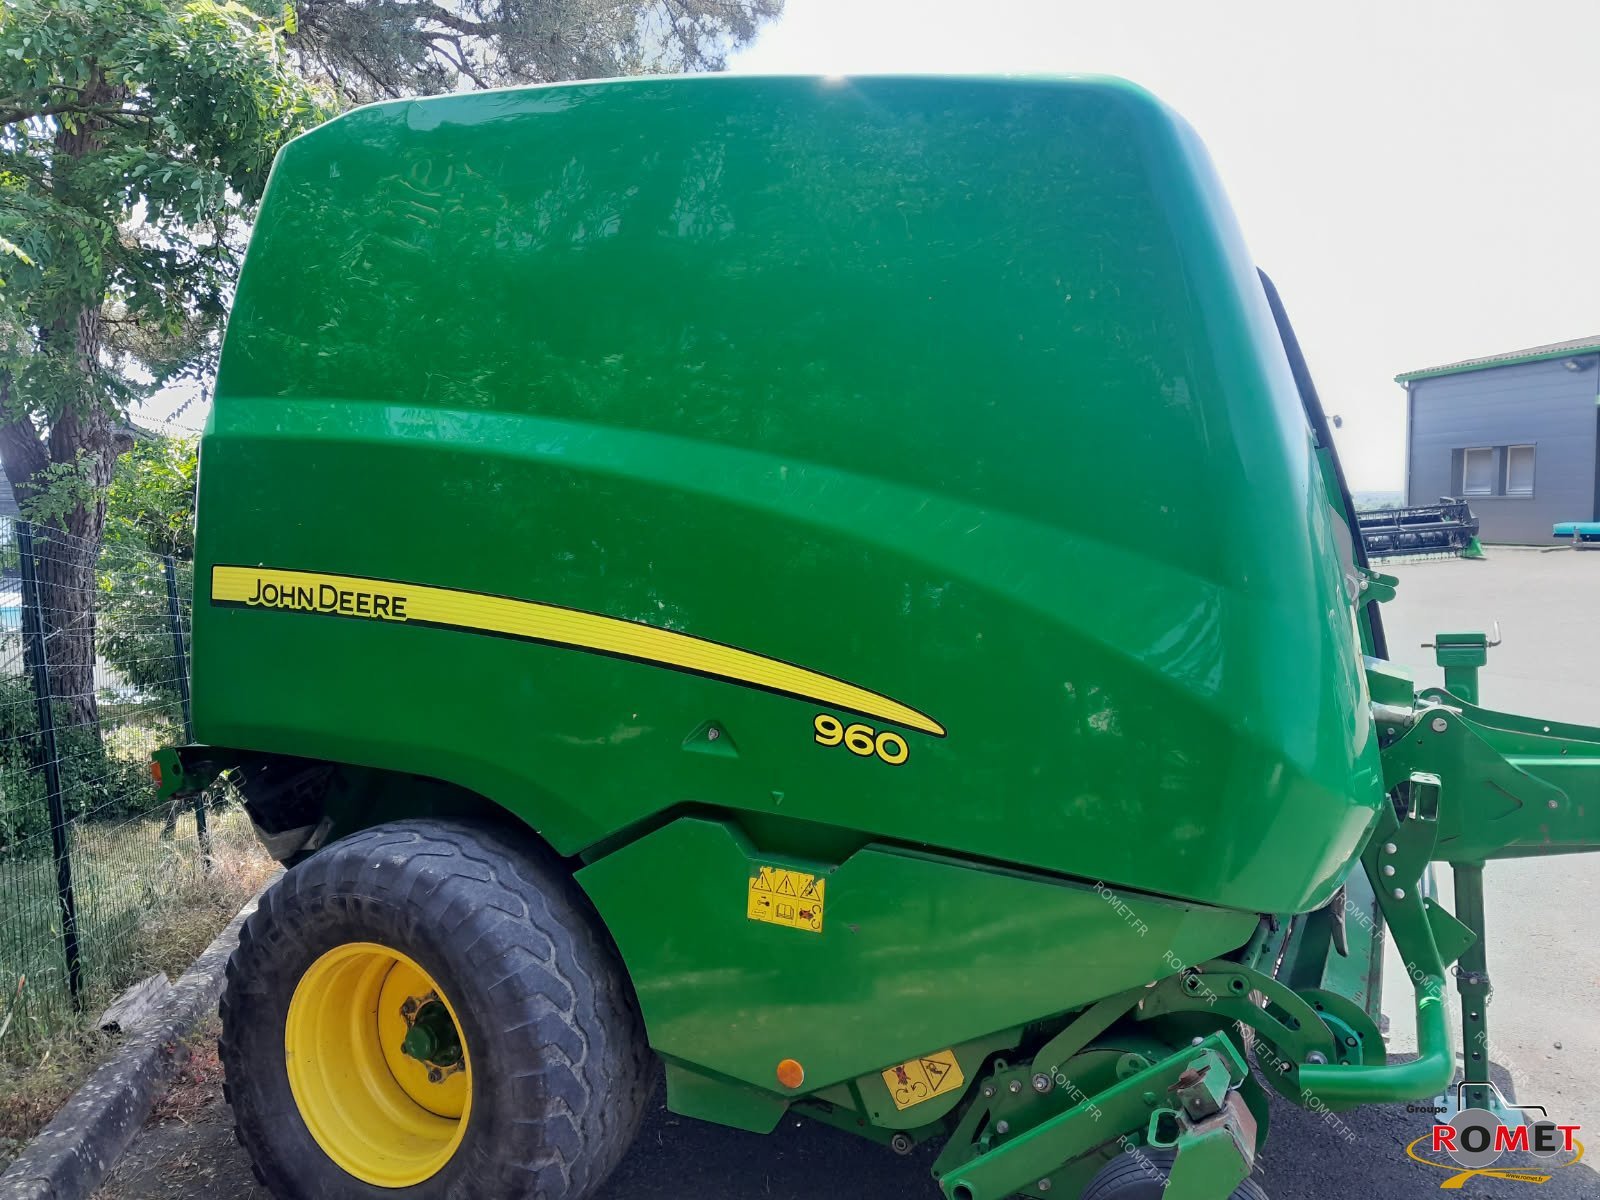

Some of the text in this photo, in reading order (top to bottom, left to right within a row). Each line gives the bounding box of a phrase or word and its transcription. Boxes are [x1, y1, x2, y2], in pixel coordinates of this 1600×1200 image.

[249, 579, 407, 618] JOHN DEERE
[813, 713, 910, 766] 960
